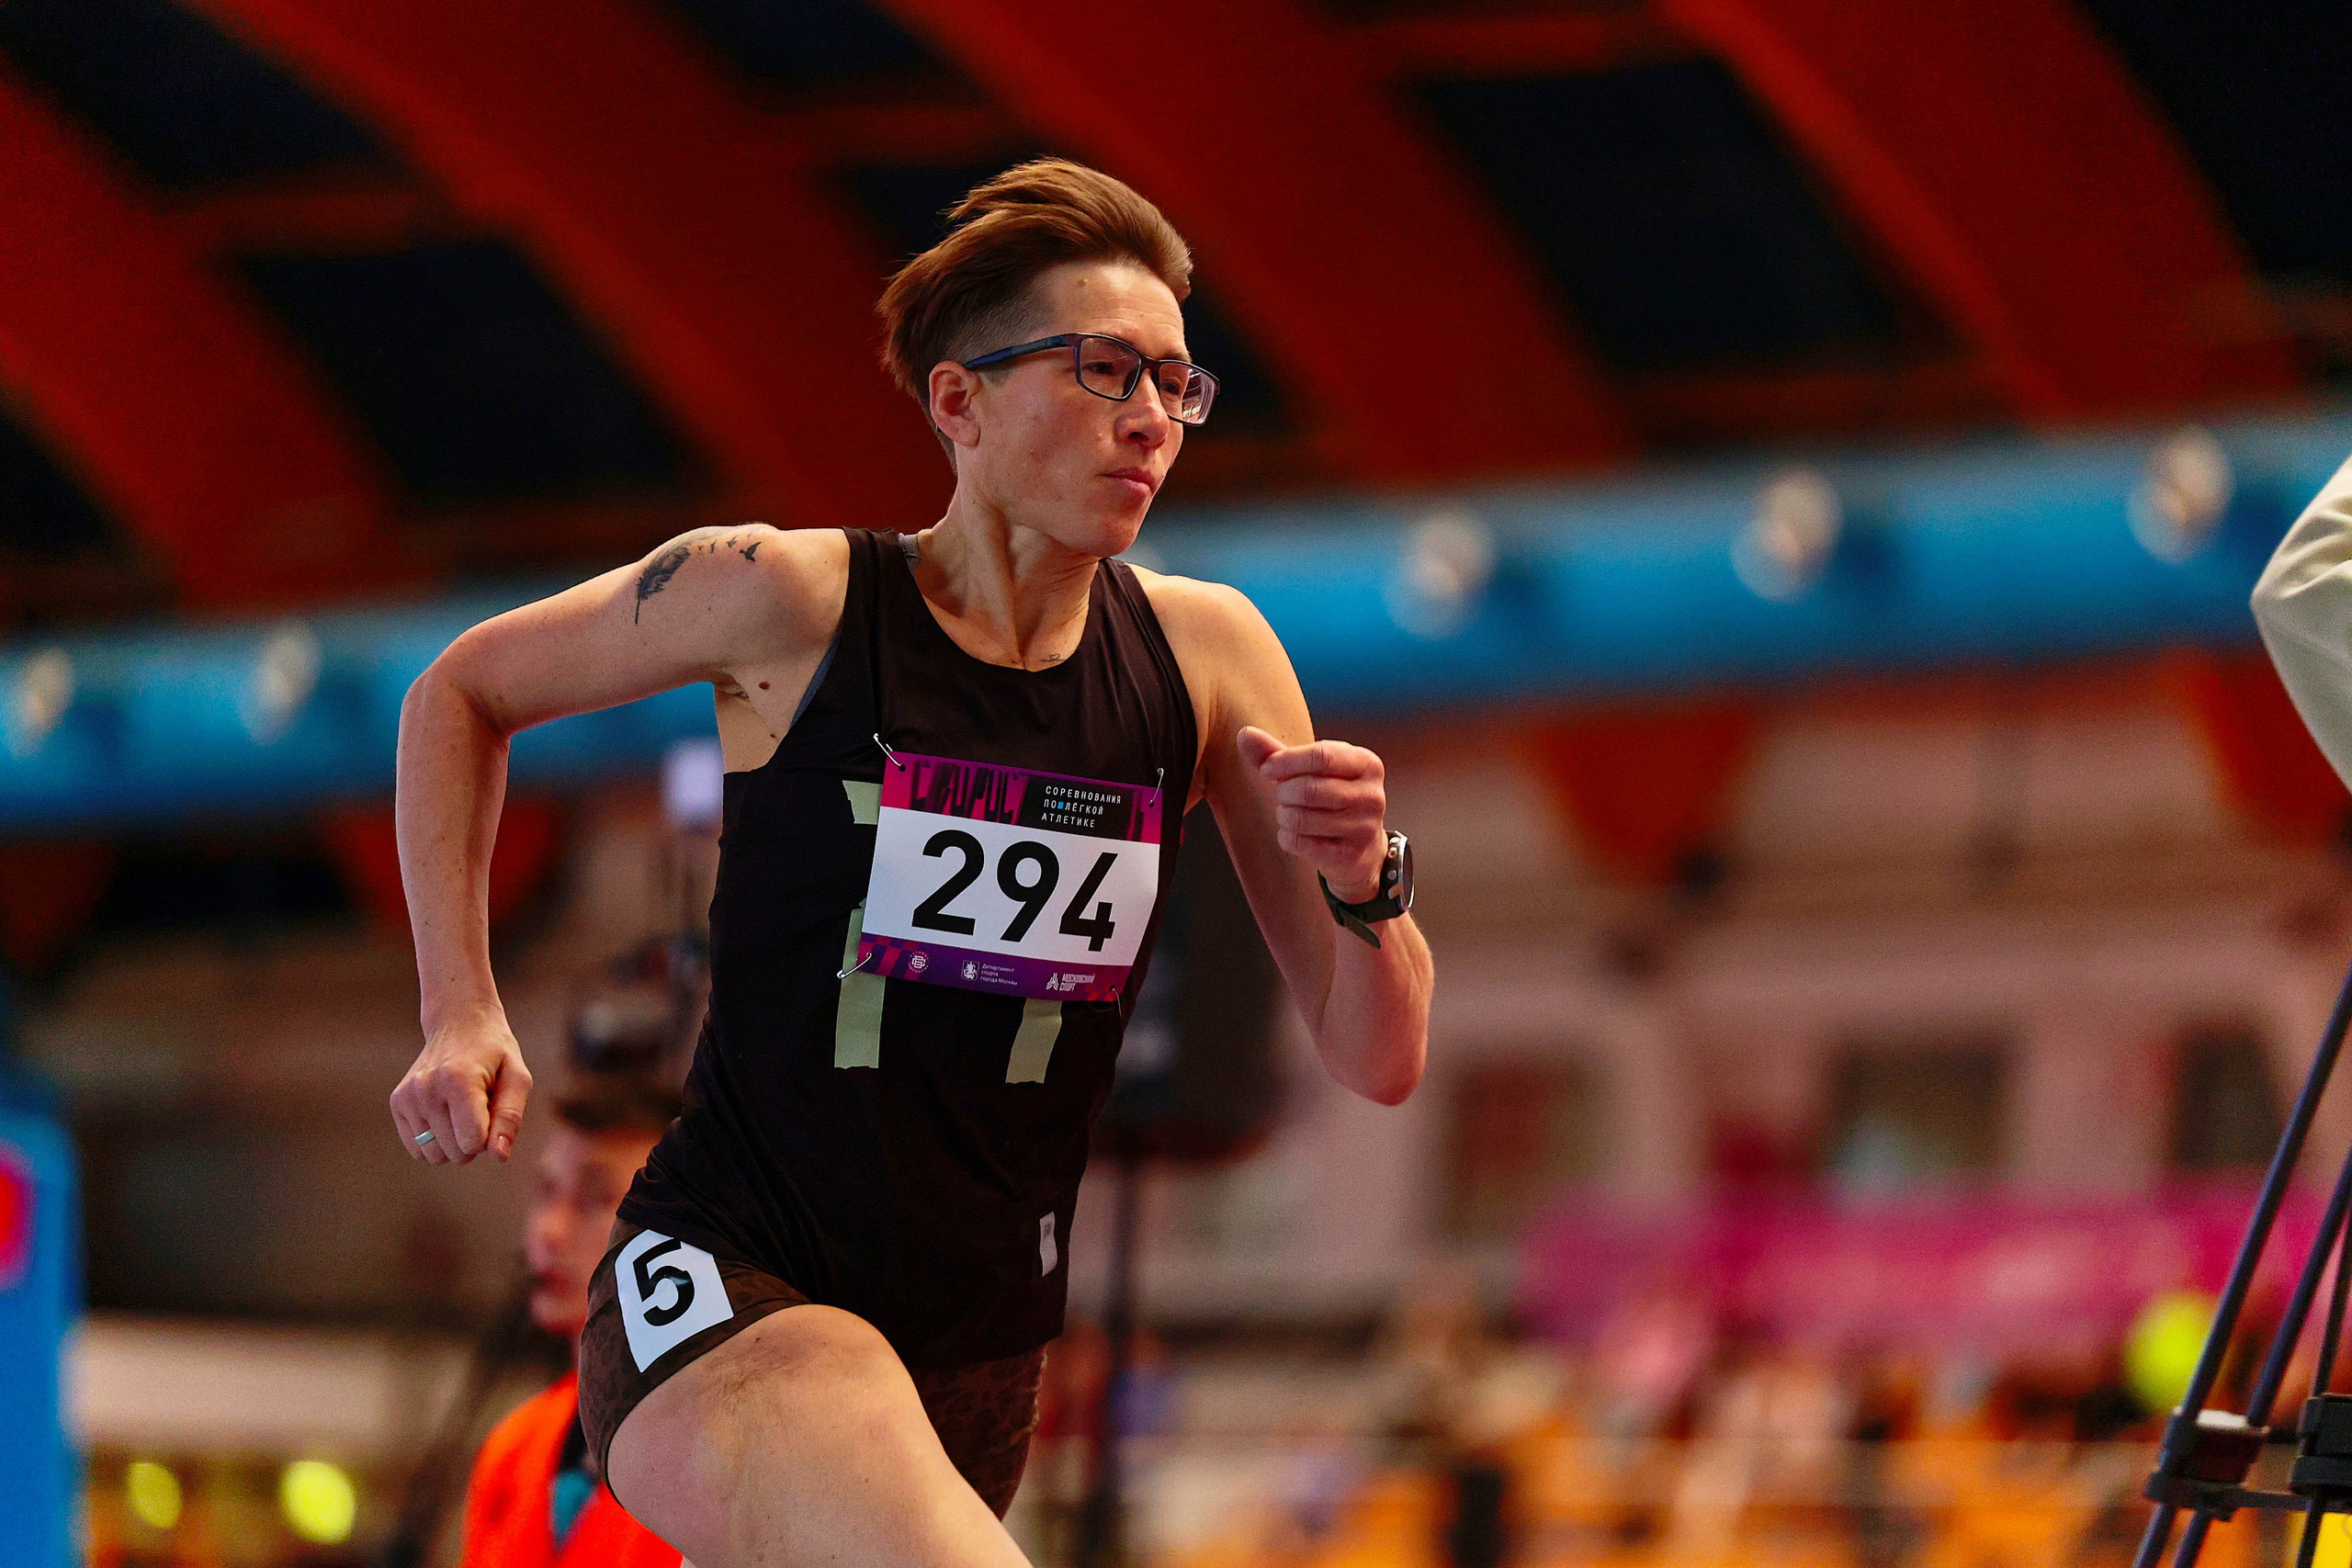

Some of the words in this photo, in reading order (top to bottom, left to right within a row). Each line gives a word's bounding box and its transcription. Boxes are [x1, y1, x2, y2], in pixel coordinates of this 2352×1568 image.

[1044, 798, 1057, 809] ПО
[1046, 785, 1122, 805] СОРЕВНОВАНИЯ
[1041, 812, 1096, 829] АТЛЕТИКЕ
[911, 829, 1119, 953] 294
[632, 1238, 695, 1327] 5
